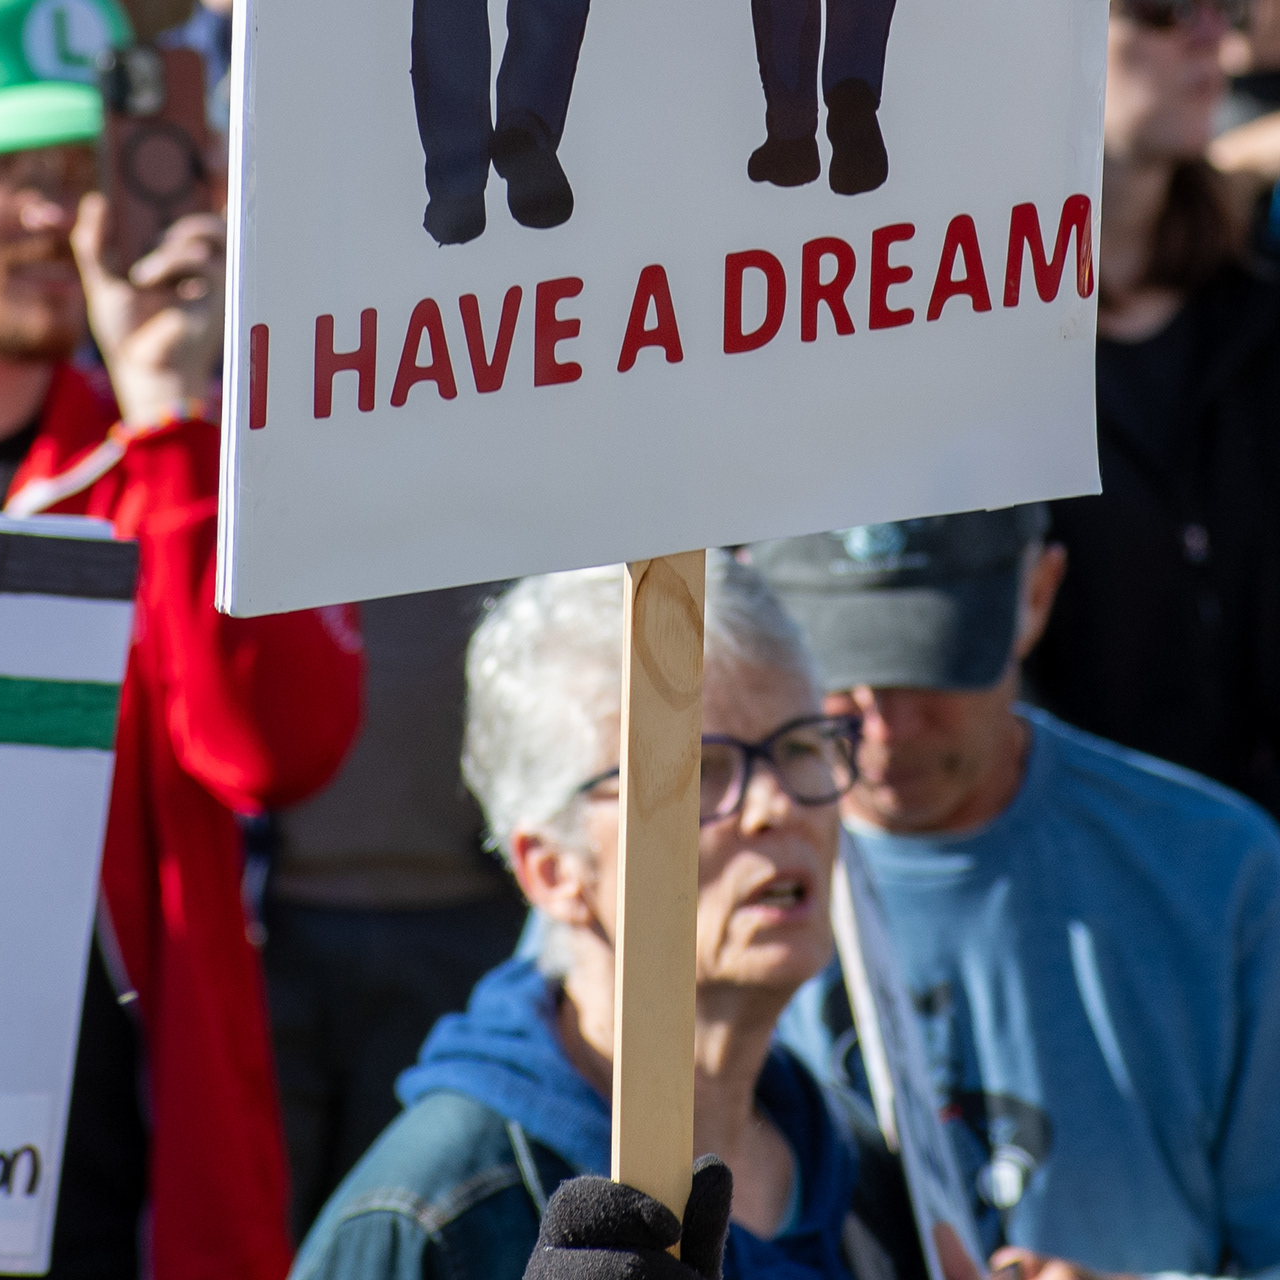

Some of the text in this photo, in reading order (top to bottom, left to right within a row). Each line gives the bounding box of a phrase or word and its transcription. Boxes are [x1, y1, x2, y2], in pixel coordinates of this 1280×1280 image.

[52, 8, 88, 66] L
[249, 192, 1096, 431] I HAVE A DREAM
